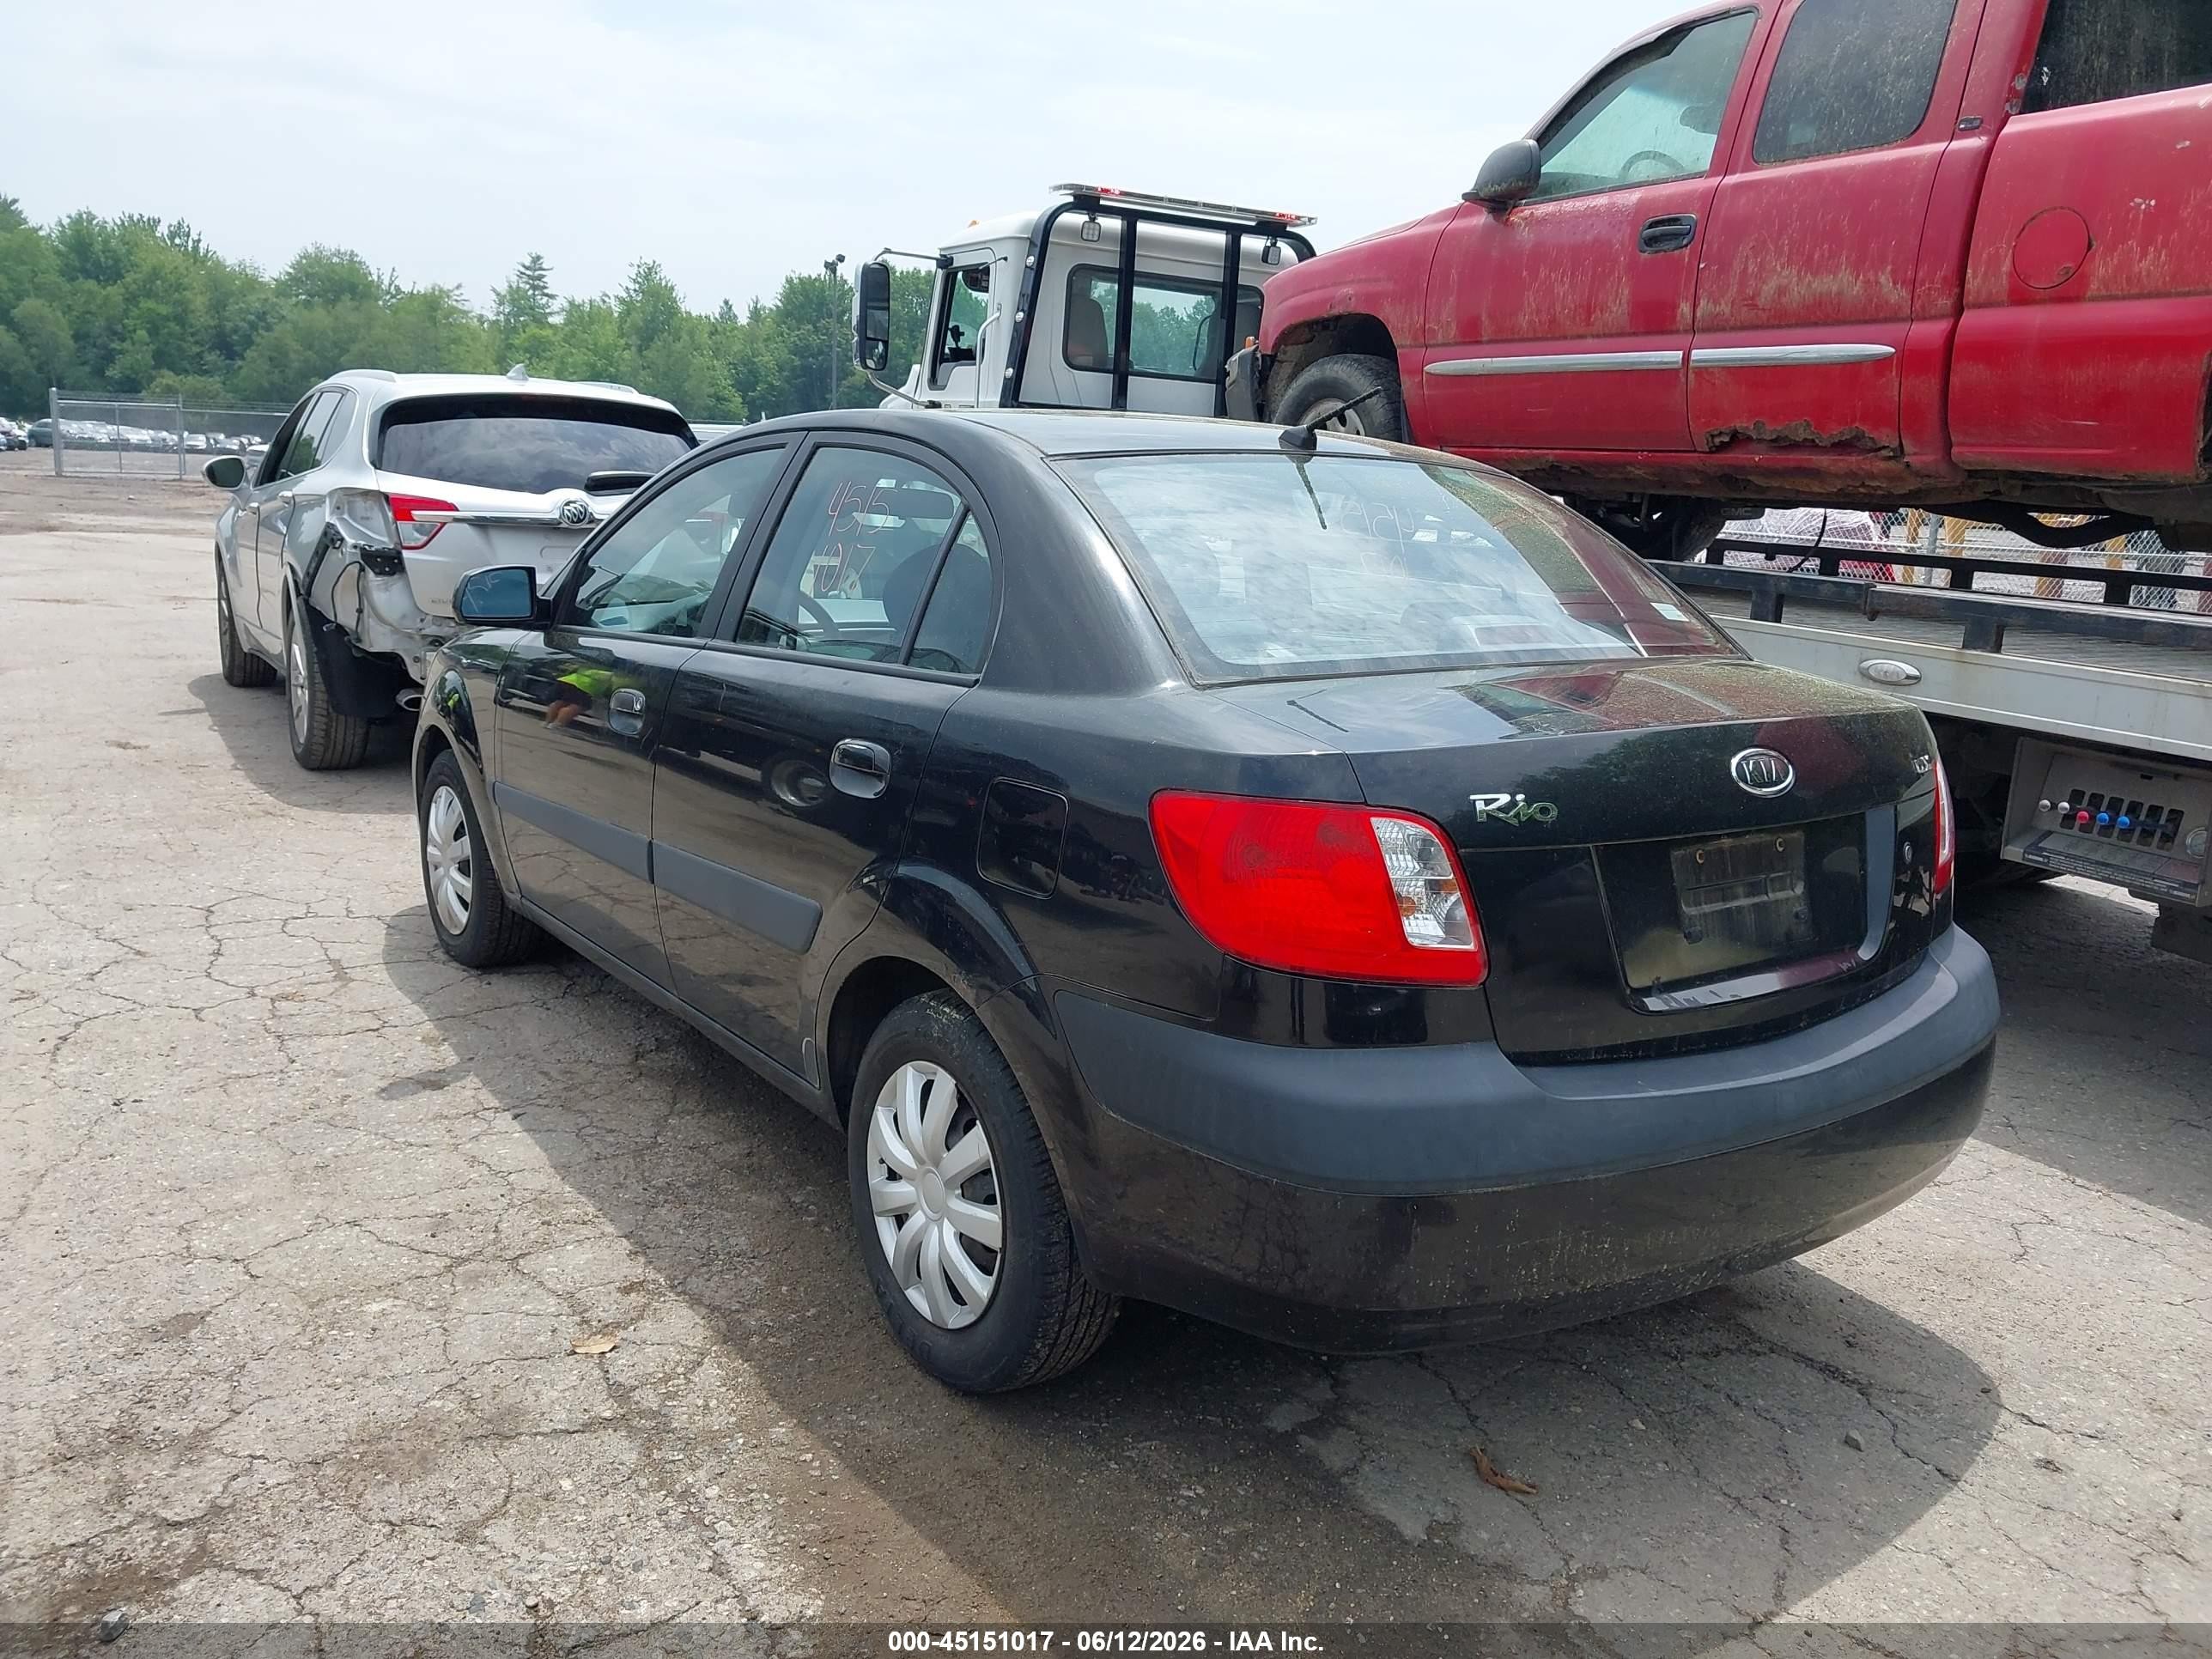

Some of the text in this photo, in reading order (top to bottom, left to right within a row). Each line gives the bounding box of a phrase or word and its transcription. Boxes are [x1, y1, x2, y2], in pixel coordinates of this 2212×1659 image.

[828, 481, 899, 537] 4515
[1720, 507, 1753, 516] GMC
[1740, 756, 1787, 786] KIA
[1469, 793, 1559, 826] Rio
